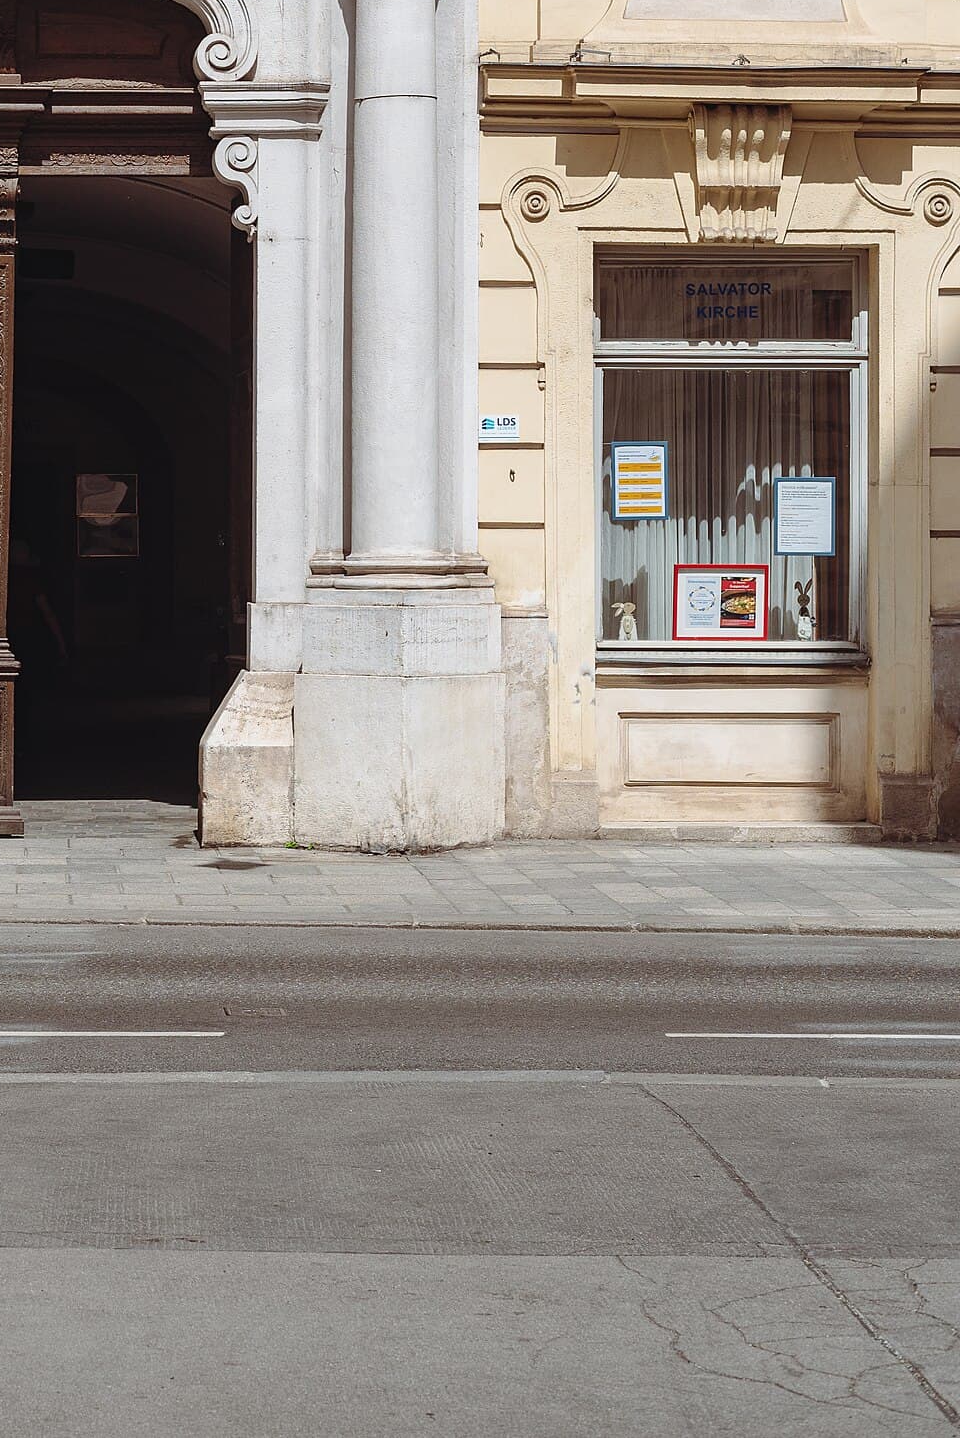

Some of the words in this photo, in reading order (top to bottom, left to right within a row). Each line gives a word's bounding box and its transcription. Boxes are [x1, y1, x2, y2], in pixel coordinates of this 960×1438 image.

[685, 282, 773, 297] SALVATOR
[696, 305, 760, 319] KIRCHE
[496, 417, 517, 427] LDS
